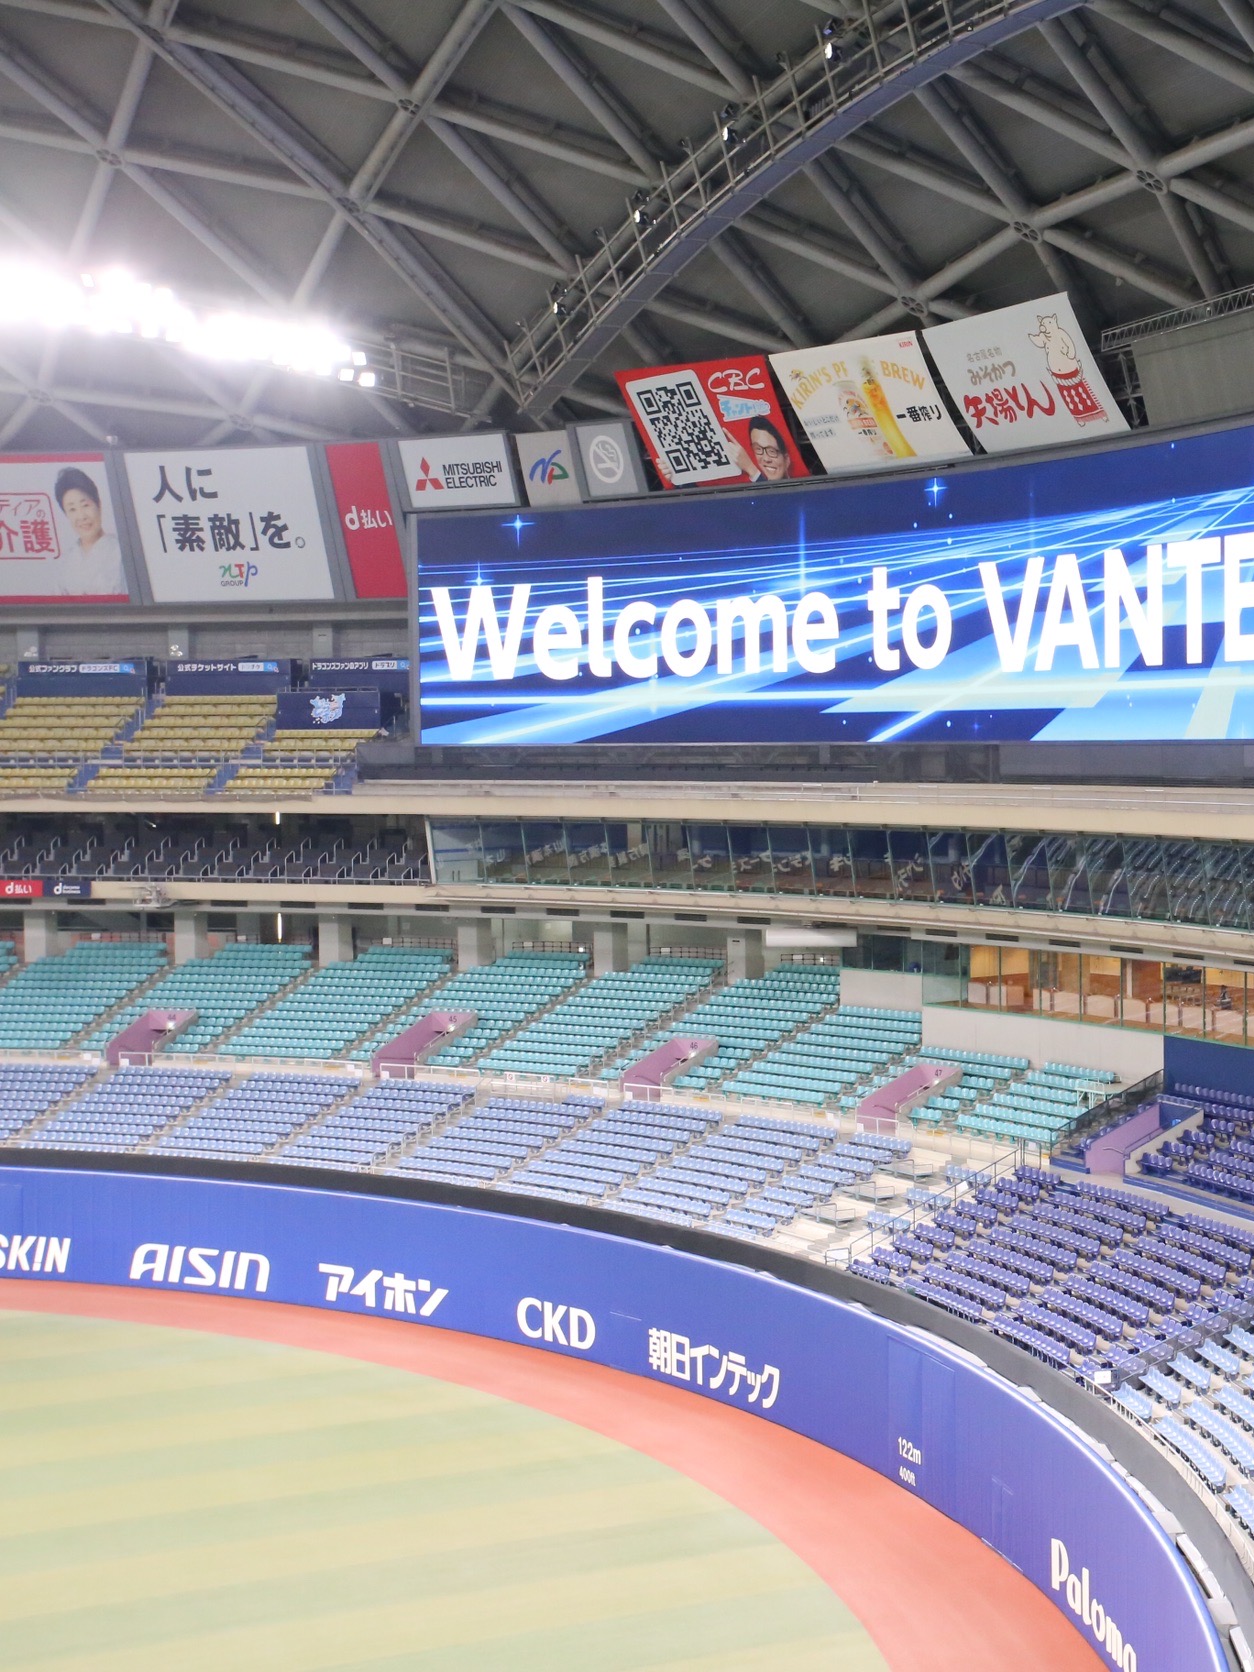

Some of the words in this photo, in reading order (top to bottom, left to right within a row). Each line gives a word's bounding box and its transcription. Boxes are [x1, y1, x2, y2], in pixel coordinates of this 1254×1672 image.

[707, 367, 765, 393] CBC
[790, 366, 833, 410] KIRIN'S
[880, 360, 927, 391] BREW
[967, 360, 1016, 385] みそかつ
[896, 404, 943, 422] 一番搾り
[963, 380, 1056, 429] 矢場とん
[153, 465, 218, 503] 人に
[443, 461, 503, 476] MITSUBISHI
[446, 474, 498, 489] ELECTRIC
[156, 511, 306, 553] 「素敵」を。
[345, 505, 393, 531] d払い
[430, 576, 840, 682] Welcome
[868, 566, 952, 672] to
[29, 664, 77, 673] 公式ファンクラブ
[177, 663, 237, 672] 公式チケットサイト
[129, 1243, 271, 1293] AISIN
[318, 1262, 449, 1317] アイホン
[516, 1296, 596, 1350] CKD
[648, 1327, 780, 1409] 朝日インテック
[898, 1436, 922, 1465] 122m
[899, 1465, 916, 1487] 400ft
[1050, 1537, 1137, 1672] Paloma
